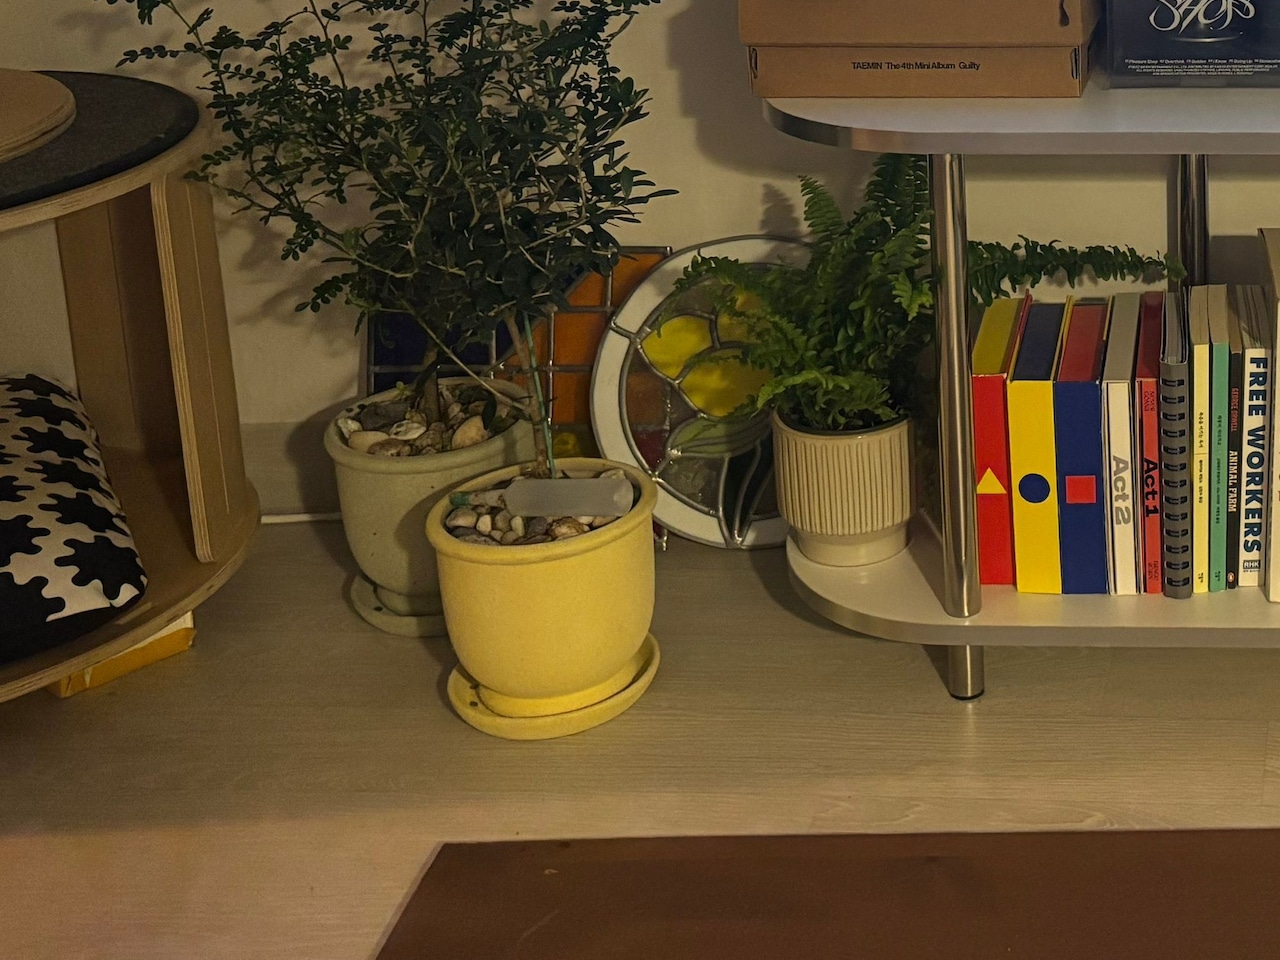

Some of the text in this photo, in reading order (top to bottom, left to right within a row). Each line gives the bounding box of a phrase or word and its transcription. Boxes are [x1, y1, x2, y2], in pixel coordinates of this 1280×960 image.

[851, 61, 981, 71] TAEMIN The 4th Mini Album Guilty
[1231, 387, 1239, 409] GEORGE
[1247, 357, 1268, 417] FREE
[1112, 455, 1131, 526] Act 2
[1143, 457, 1159, 517] Act 1
[1227, 450, 1238, 513] ANIMAL FARM
[1243, 424, 1266, 554] WORKERS
[1243, 560, 1260, 569] RHK
